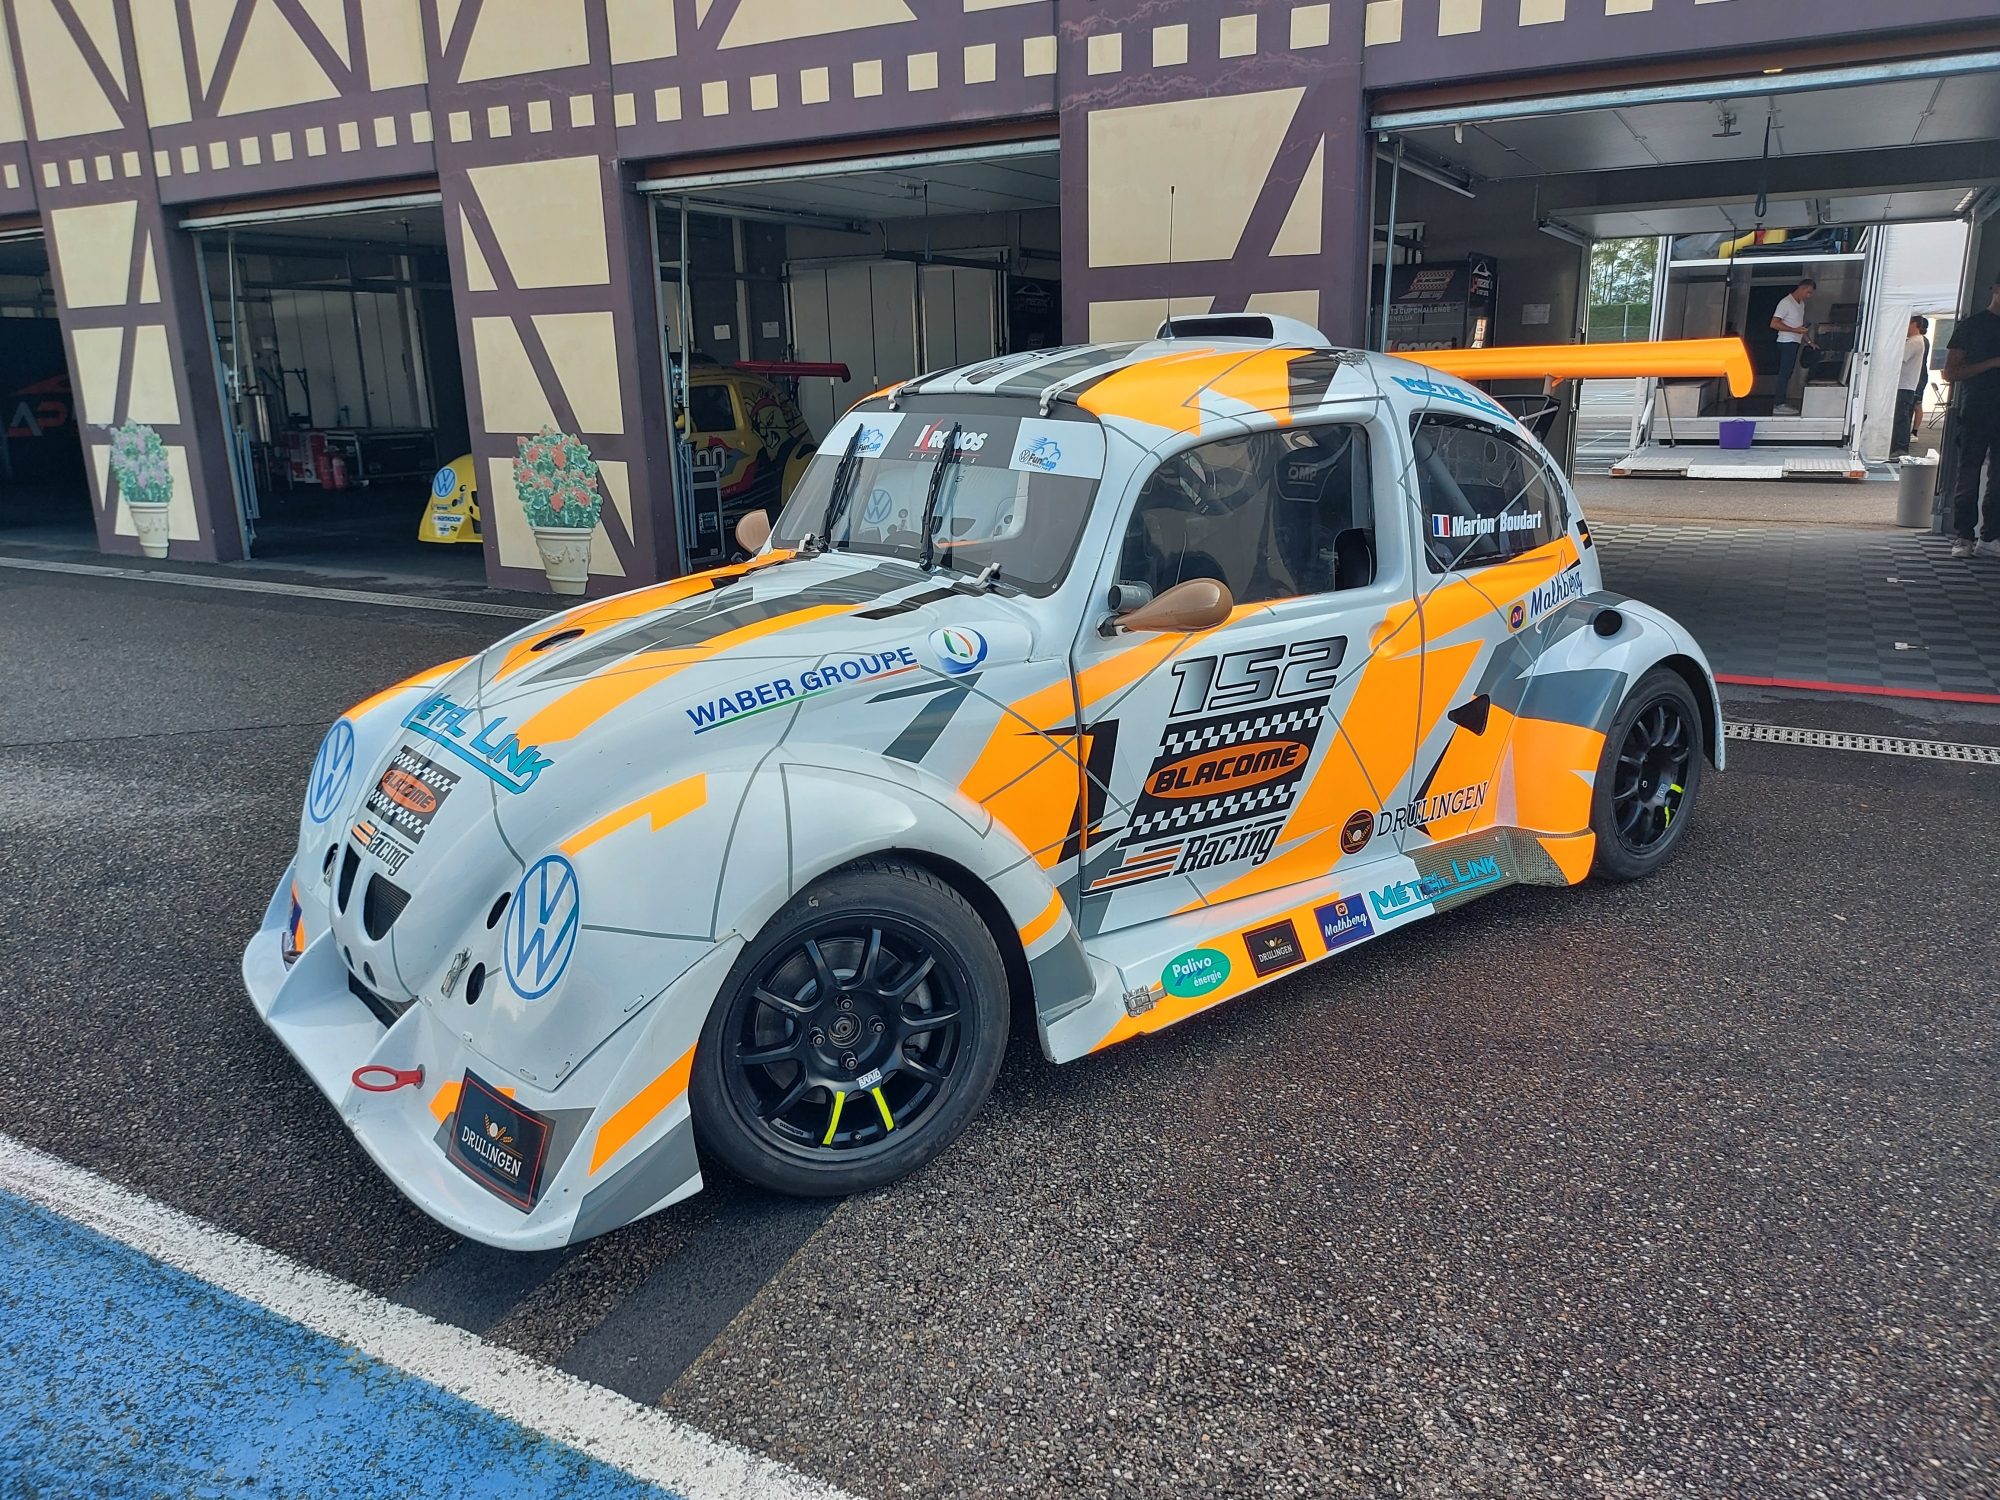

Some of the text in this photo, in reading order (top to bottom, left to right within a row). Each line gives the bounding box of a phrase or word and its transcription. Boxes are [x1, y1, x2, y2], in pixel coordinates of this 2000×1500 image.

[908, 452, 977, 464] EVETS
[1029, 453, 1057, 471] FunCup
[1287, 465, 1318, 481] OMP
[1452, 510, 1542, 537] Marion Boudart
[686, 647, 918, 727] WABER GROUPE
[1169, 635, 1348, 718] 152
[469, 716, 555, 778] LINK
[1152, 743, 1301, 794] BLACOME
[383, 771, 436, 809] BLACOME
[1377, 781, 1488, 837] DRULINGEN
[366, 828, 411, 877] Racing
[1172, 823, 1284, 876] Racing
[1451, 855, 1500, 882] LINK
[1172, 957, 1212, 978] Palivo
[1258, 944, 1293, 962] DRULINGEN
[1194, 970, 1222, 987] énergie
[462, 1125, 522, 1177] DRULINGEN
